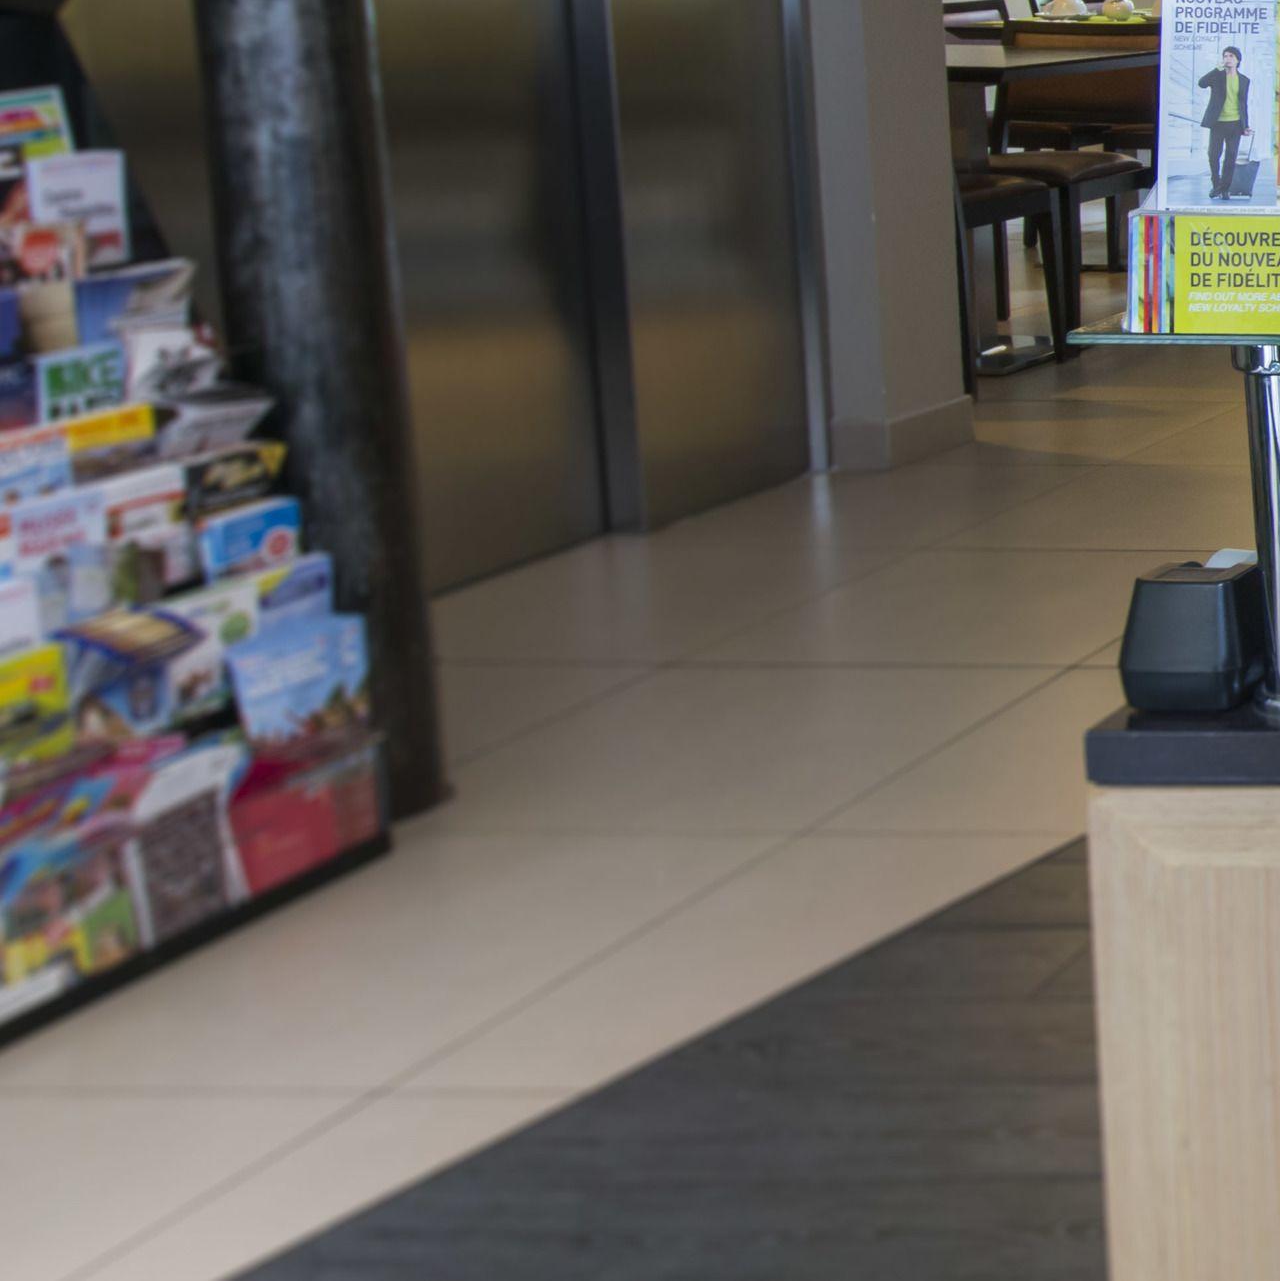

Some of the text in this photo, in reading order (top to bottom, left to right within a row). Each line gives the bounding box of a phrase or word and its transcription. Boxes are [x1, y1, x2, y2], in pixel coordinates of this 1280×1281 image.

[1175, 6, 1268, 21] PROGRAMME
[1174, 21, 1195, 34] DE
[1190, 252, 1214, 267] DU
[1190, 272, 1212, 287] DE
[1188, 292, 1213, 302] FIND
[1214, 292, 1235, 302] OUT
[1237, 292, 1266, 302] MORE
[1188, 303, 1211, 313] NEW
[1213, 303, 1257, 313] LOYALTY
